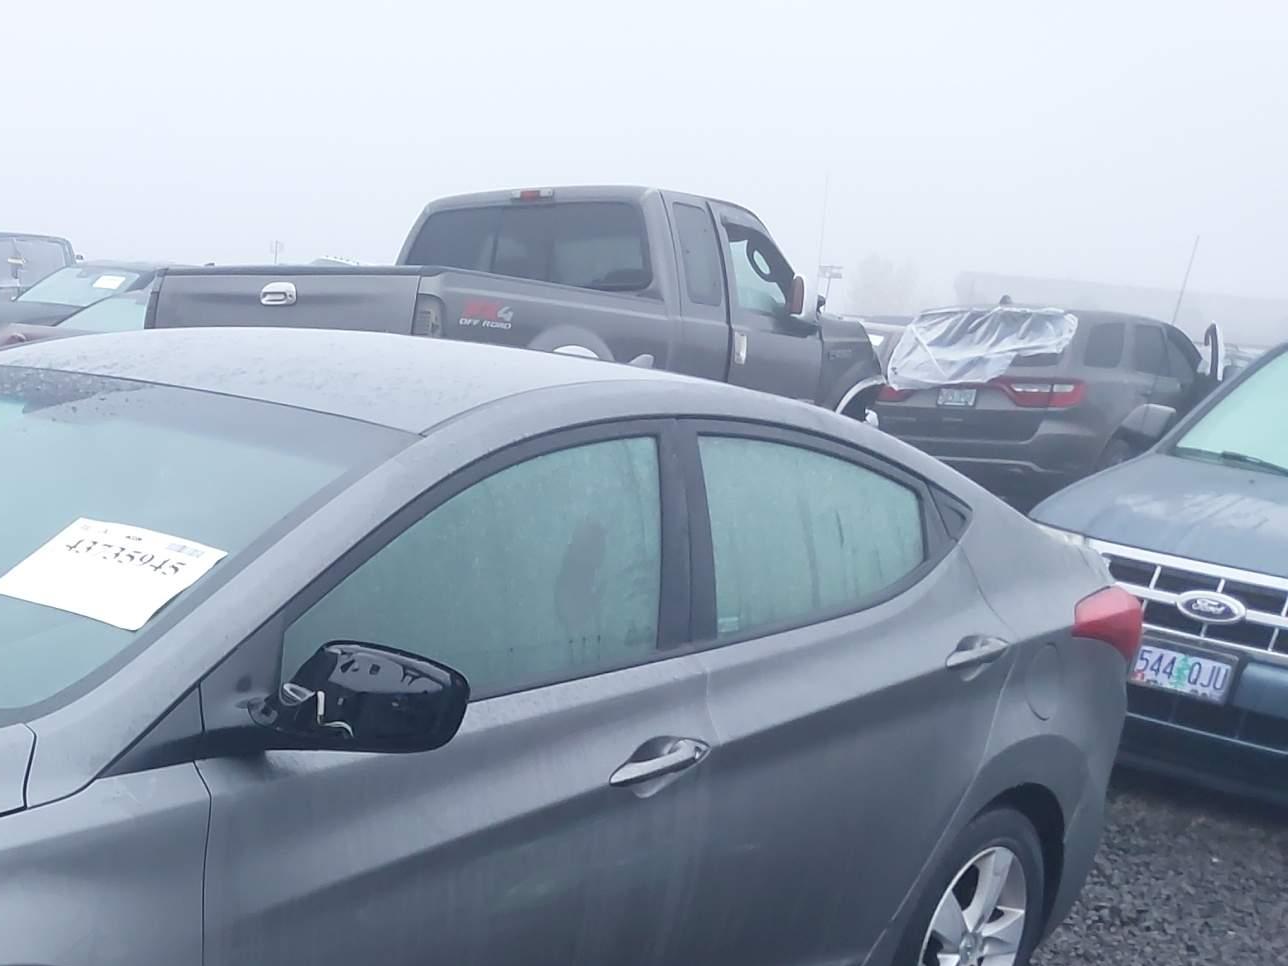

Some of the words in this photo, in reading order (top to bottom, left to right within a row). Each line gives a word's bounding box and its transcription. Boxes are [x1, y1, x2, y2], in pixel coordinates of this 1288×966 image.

[1191, 598, 1225, 615] Ford
[1134, 649, 1177, 679] 544
[1188, 662, 1229, 690] QJU
